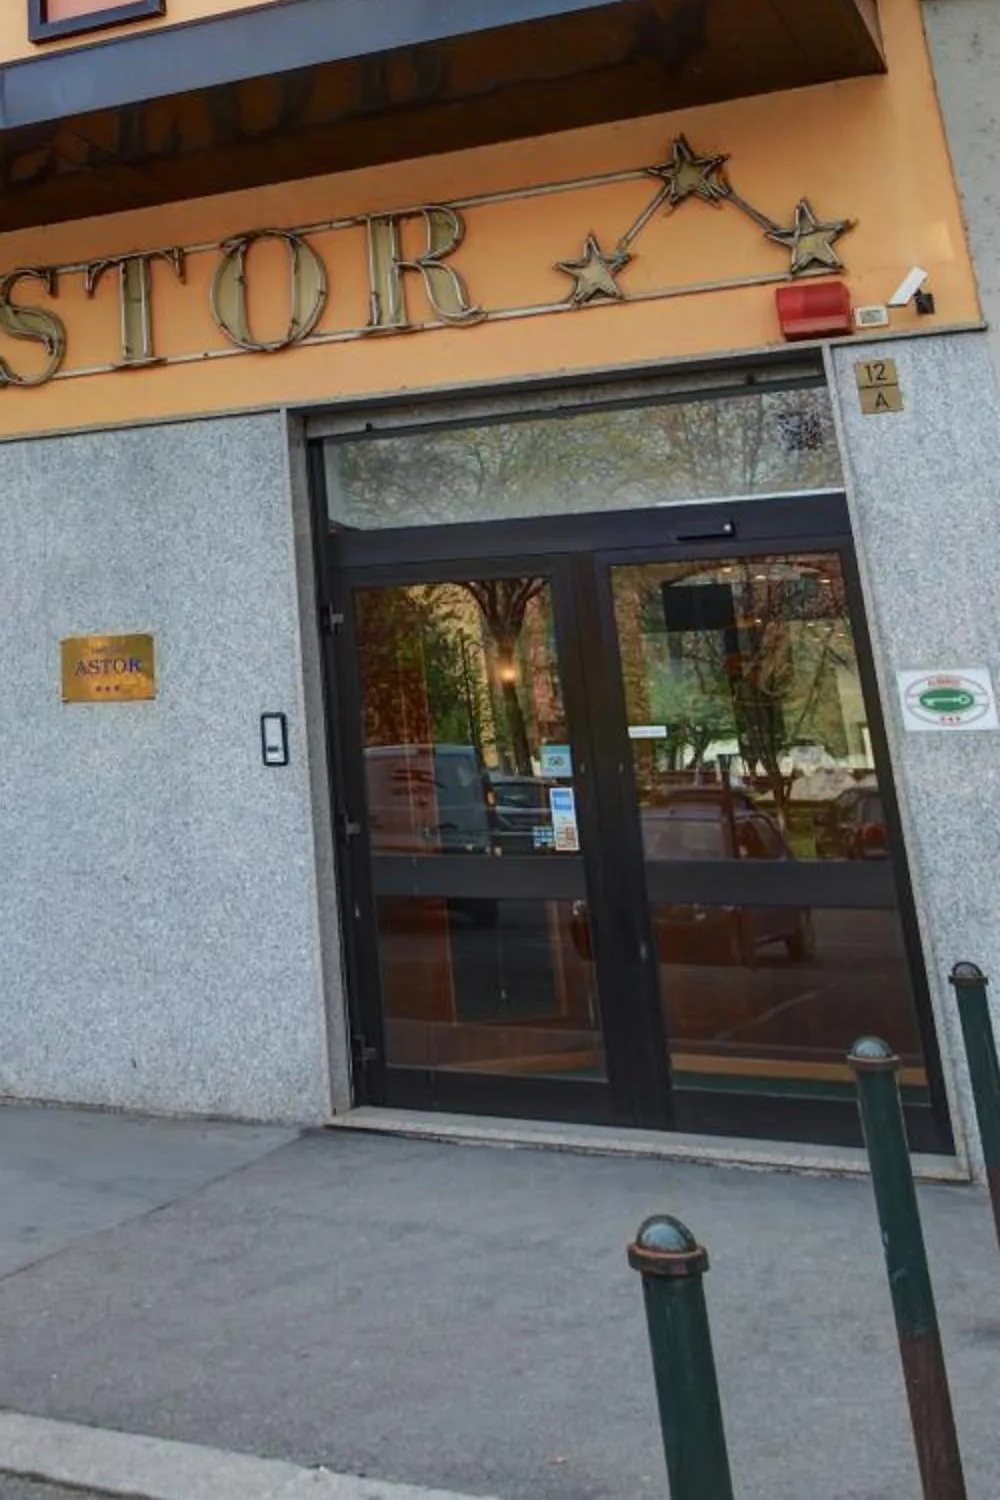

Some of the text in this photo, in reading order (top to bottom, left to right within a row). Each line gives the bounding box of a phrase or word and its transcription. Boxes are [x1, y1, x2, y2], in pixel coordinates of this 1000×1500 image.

[864, 363, 887, 383] 12
[874, 392, 889, 408] A
[74, 657, 142, 676] ASTOR
